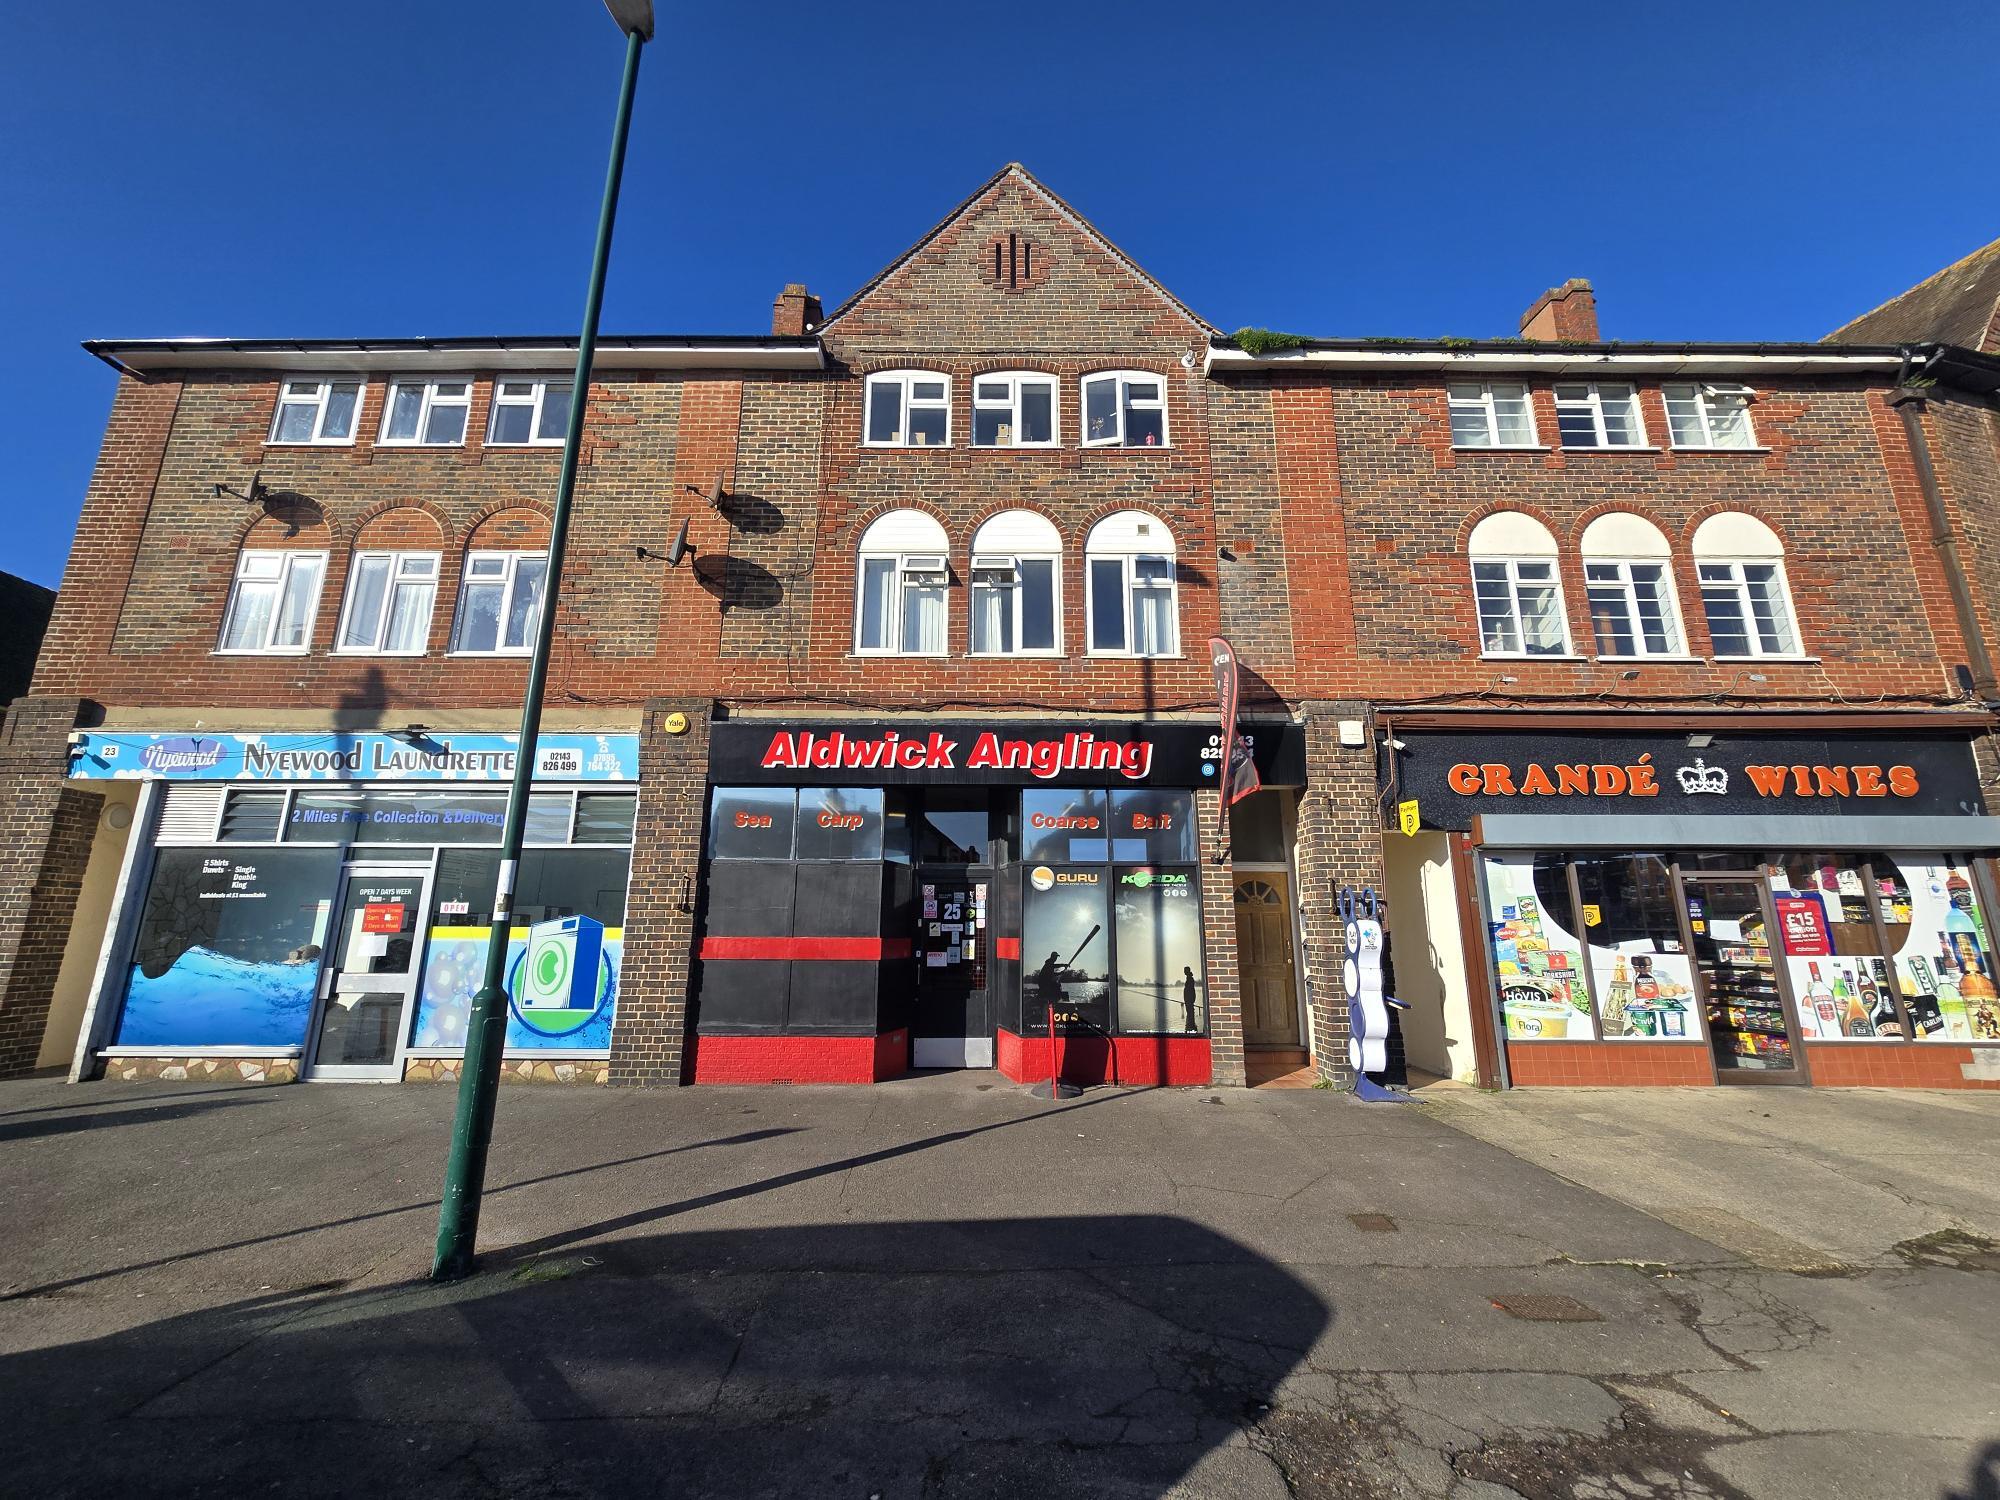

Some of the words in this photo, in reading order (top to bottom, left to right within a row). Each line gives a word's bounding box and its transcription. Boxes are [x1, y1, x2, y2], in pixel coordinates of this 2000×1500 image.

[668, 719, 684, 727] Yale
[104, 747, 116, 756] 23
[146, 741, 222, 772] Nyewood
[760, 730, 959, 769] Aldwick
[966, 731, 1154, 779] Angling
[542, 761, 560, 771] 826
[561, 761, 577, 771] 499
[1447, 752, 1660, 798] GRANDÉ
[1744, 764, 1920, 799] WINES
[292, 810, 301, 823] 2
[303, 809, 338, 823] Miles
[373, 810, 439, 824] Collection
[734, 811, 773, 828] Sea
[817, 809, 864, 831] Carp
[1031, 811, 1100, 830] Coarse
[1131, 811, 1172, 830] Bait
[203, 859, 210, 867] 5
[210, 859, 230, 867] Shirts
[234, 866, 256, 874] Single
[233, 873, 257, 881] Double
[1056, 873, 1099, 883] GURU
[231, 881, 248, 890] King
[443, 904, 466, 912] OPEN
[943, 903, 961, 920] 25
[1786, 911, 1815, 928] £15
[1542, 970, 1576, 979] YORKSHIRE
[1505, 990, 1541, 1001] HOVIS
[1518, 1020, 1540, 1032] Flora
